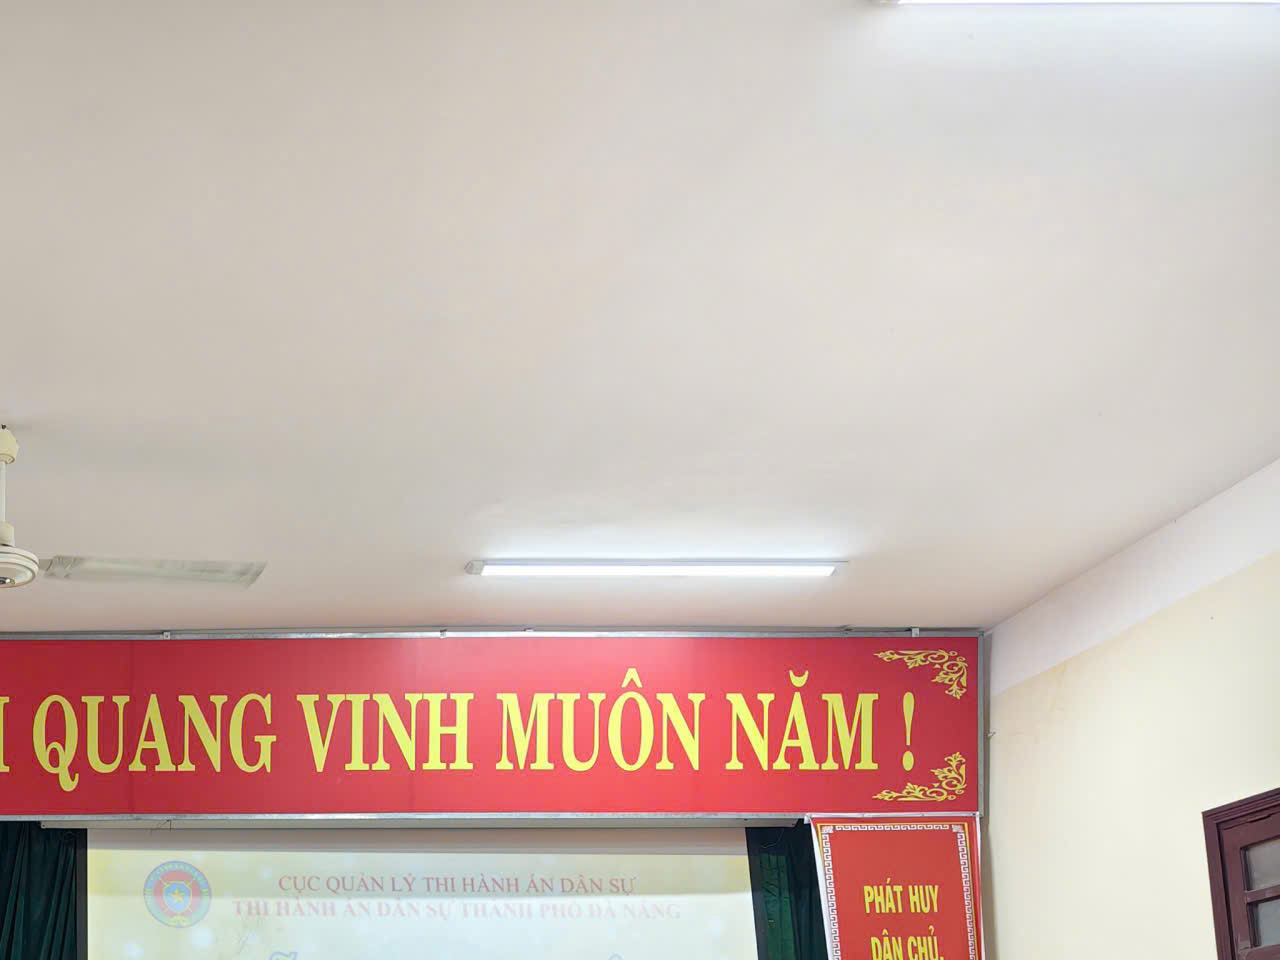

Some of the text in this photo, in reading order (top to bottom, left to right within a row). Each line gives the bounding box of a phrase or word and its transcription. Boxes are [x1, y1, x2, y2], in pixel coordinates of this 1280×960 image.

[33, 694, 276, 791] QUANG
[297, 693, 474, 772] VINH
[496, 667, 700, 771] MUÔN
[725, 670, 878, 771] NĂM
[902, 692, 915, 771] !
[278, 875, 321, 894] CỤC
[325, 872, 384, 895] QUẢN
[422, 876, 456, 892] THI
[462, 873, 520, 893] HÀNH
[525, 873, 554, 893] ÁN
[560, 874, 603, 893] DÂN
[609, 876, 637, 896] SỰ
[864, 878, 938, 913] PHÁT HUY
